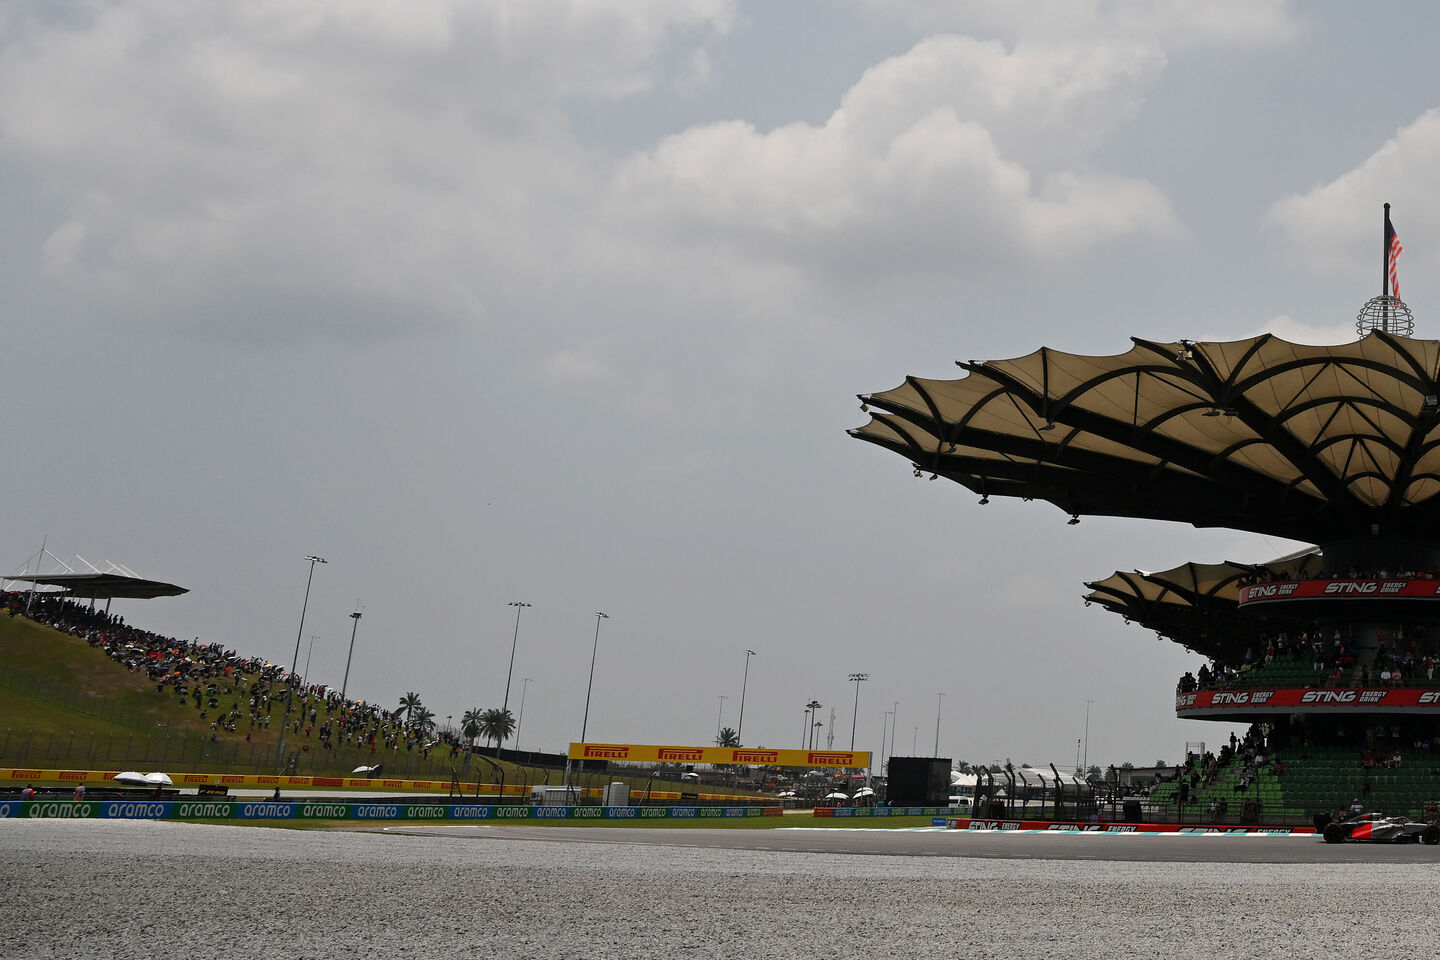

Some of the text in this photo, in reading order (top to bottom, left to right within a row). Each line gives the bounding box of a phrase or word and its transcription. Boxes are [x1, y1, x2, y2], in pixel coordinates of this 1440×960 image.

[1248, 585, 1277, 598] STING
[1324, 582, 1378, 593] STING
[1211, 692, 1249, 704] STING
[1301, 691, 1357, 702] STING
[584, 746, 629, 758] PIRELLI
[658, 748, 703, 761] PIRELLI
[733, 750, 778, 763] PIRELLI
[807, 753, 853, 765] PIRELLI
[12, 770, 42, 779] PIRELLI
[59, 771, 88, 780] PIRELLI
[184, 775, 208, 783] PIRELLI
[29, 804, 91, 818] aramco
[108, 803, 165, 817] aramco
[179, 804, 230, 817] aramco
[244, 804, 291, 817] aramco
[303, 804, 346, 817] aramco
[357, 806, 397, 817] aramco
[407, 806, 444, 817] aramco
[453, 806, 488, 817] aramco
[496, 807, 528, 817] aramco
[536, 807, 566, 817] aramco
[574, 807, 602, 817] aramco
[609, 807, 635, 817] aramco
[641, 807, 666, 817] aramco
[672, 807, 695, 817] aramco
[1002, 822, 1020, 830] ENERGY
